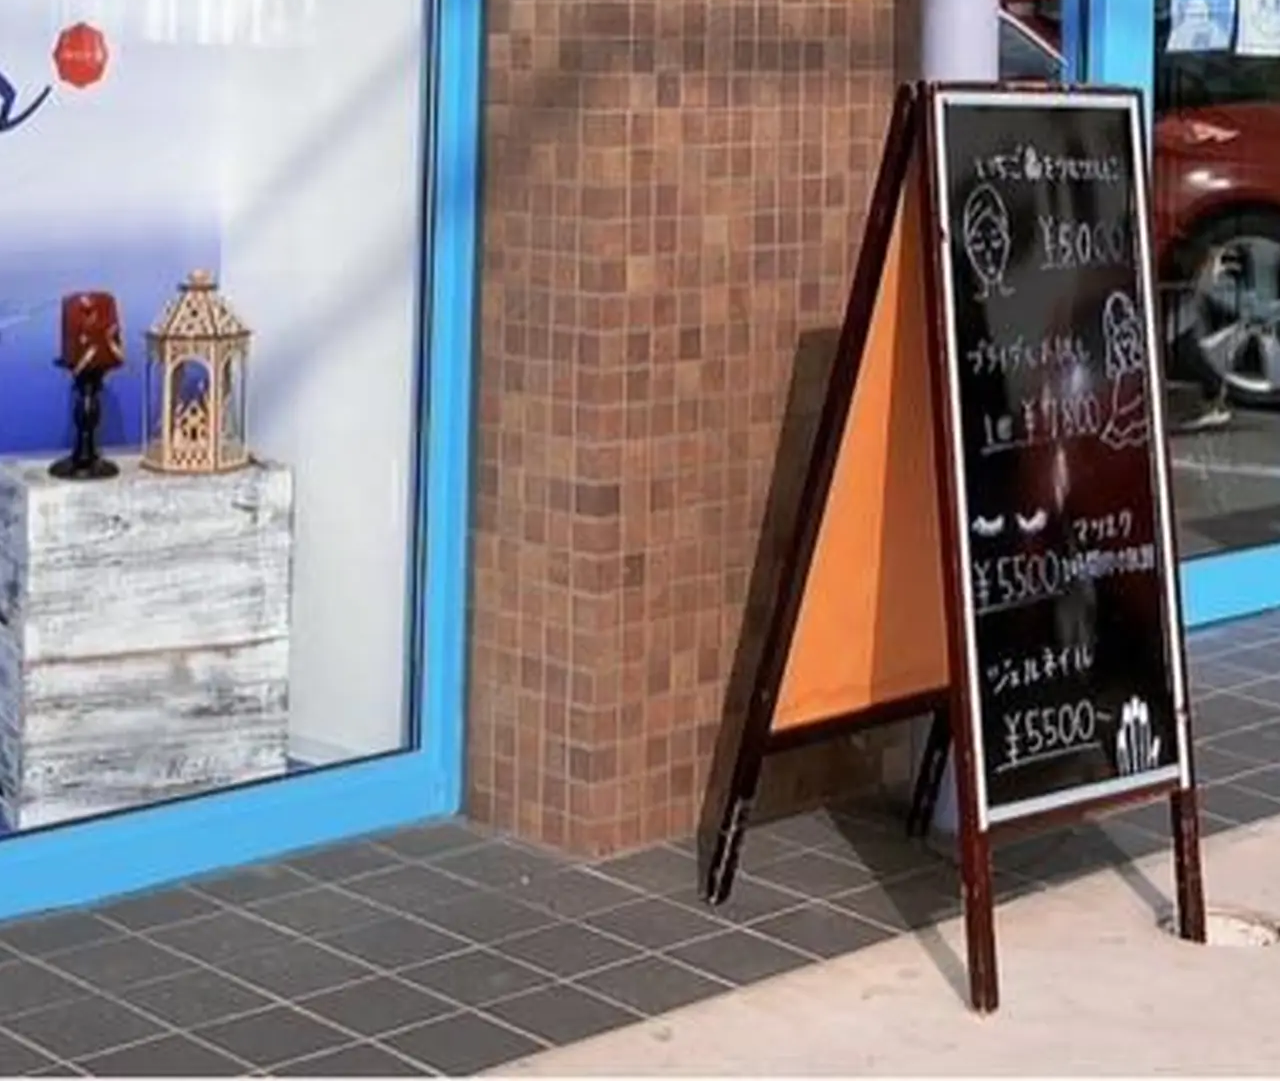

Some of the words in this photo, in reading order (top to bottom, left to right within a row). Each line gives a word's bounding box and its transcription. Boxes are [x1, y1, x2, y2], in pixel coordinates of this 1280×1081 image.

[986, 645, 1094, 694] ジェルネイル
